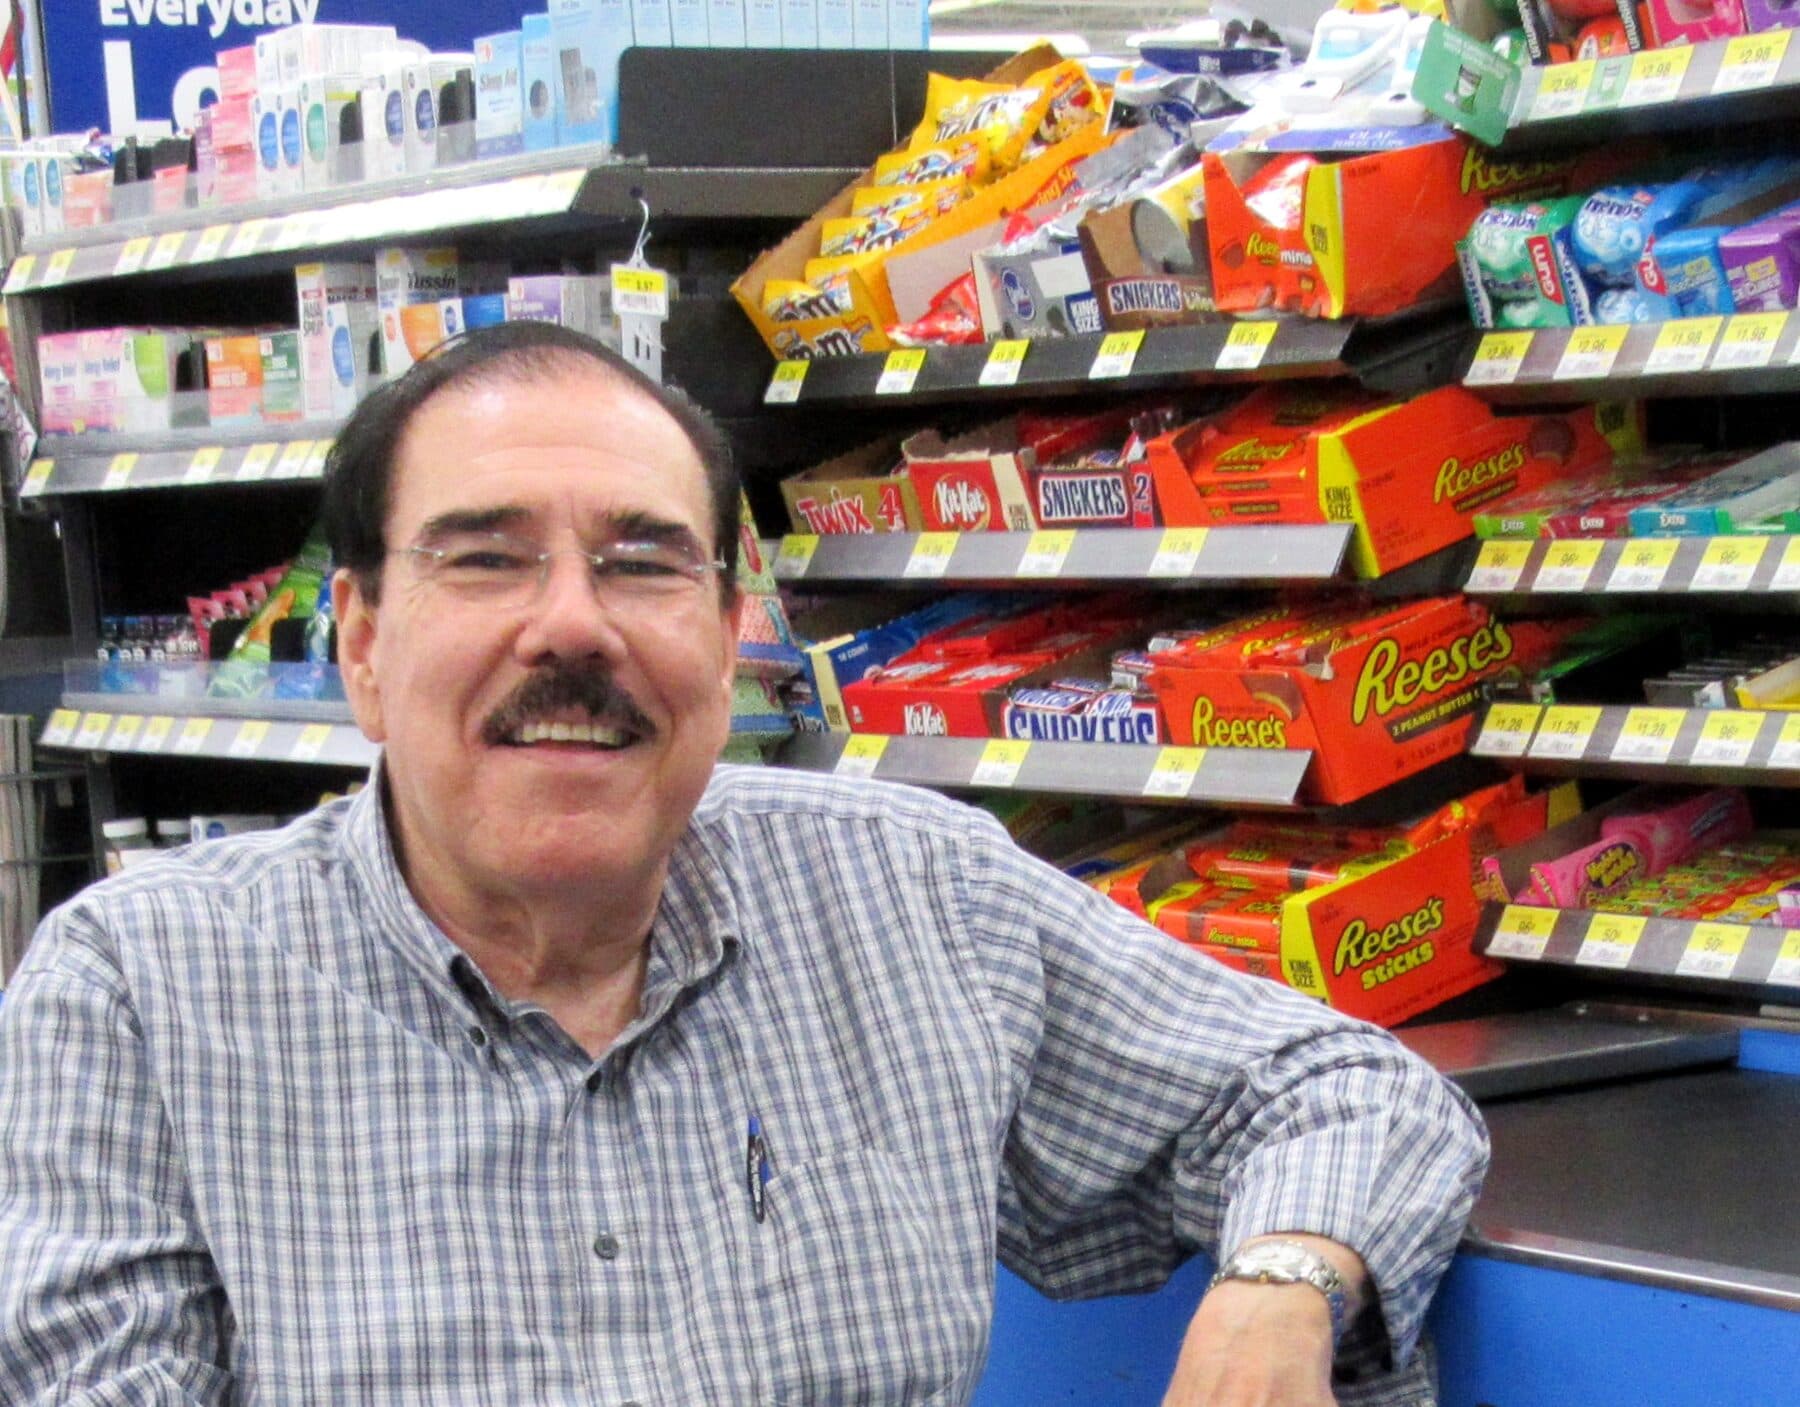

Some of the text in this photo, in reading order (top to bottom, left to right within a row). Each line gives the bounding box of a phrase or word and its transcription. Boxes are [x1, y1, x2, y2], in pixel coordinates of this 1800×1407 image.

[100, 0, 319, 39] Everyday
[1070, 299, 1099, 318] KING
[1111, 282, 1182, 313] SNICKERS
[1075, 315, 1102, 333] SIZE
[1133, 475, 1148, 500] 2
[1433, 442, 1525, 504] Reese's
[877, 488, 901, 531] 4
[1042, 477, 1126, 518] SNICKERS
[1327, 503, 1354, 519] SIZE
[1353, 615, 1513, 726] Reese's
[1009, 707, 1155, 744] SNICKERS
[1191, 696, 1287, 749] Reese's
[1400, 709, 1437, 733] PEANUT
[1334, 896, 1445, 976] Reese's
[1361, 942, 1435, 991] sticks
